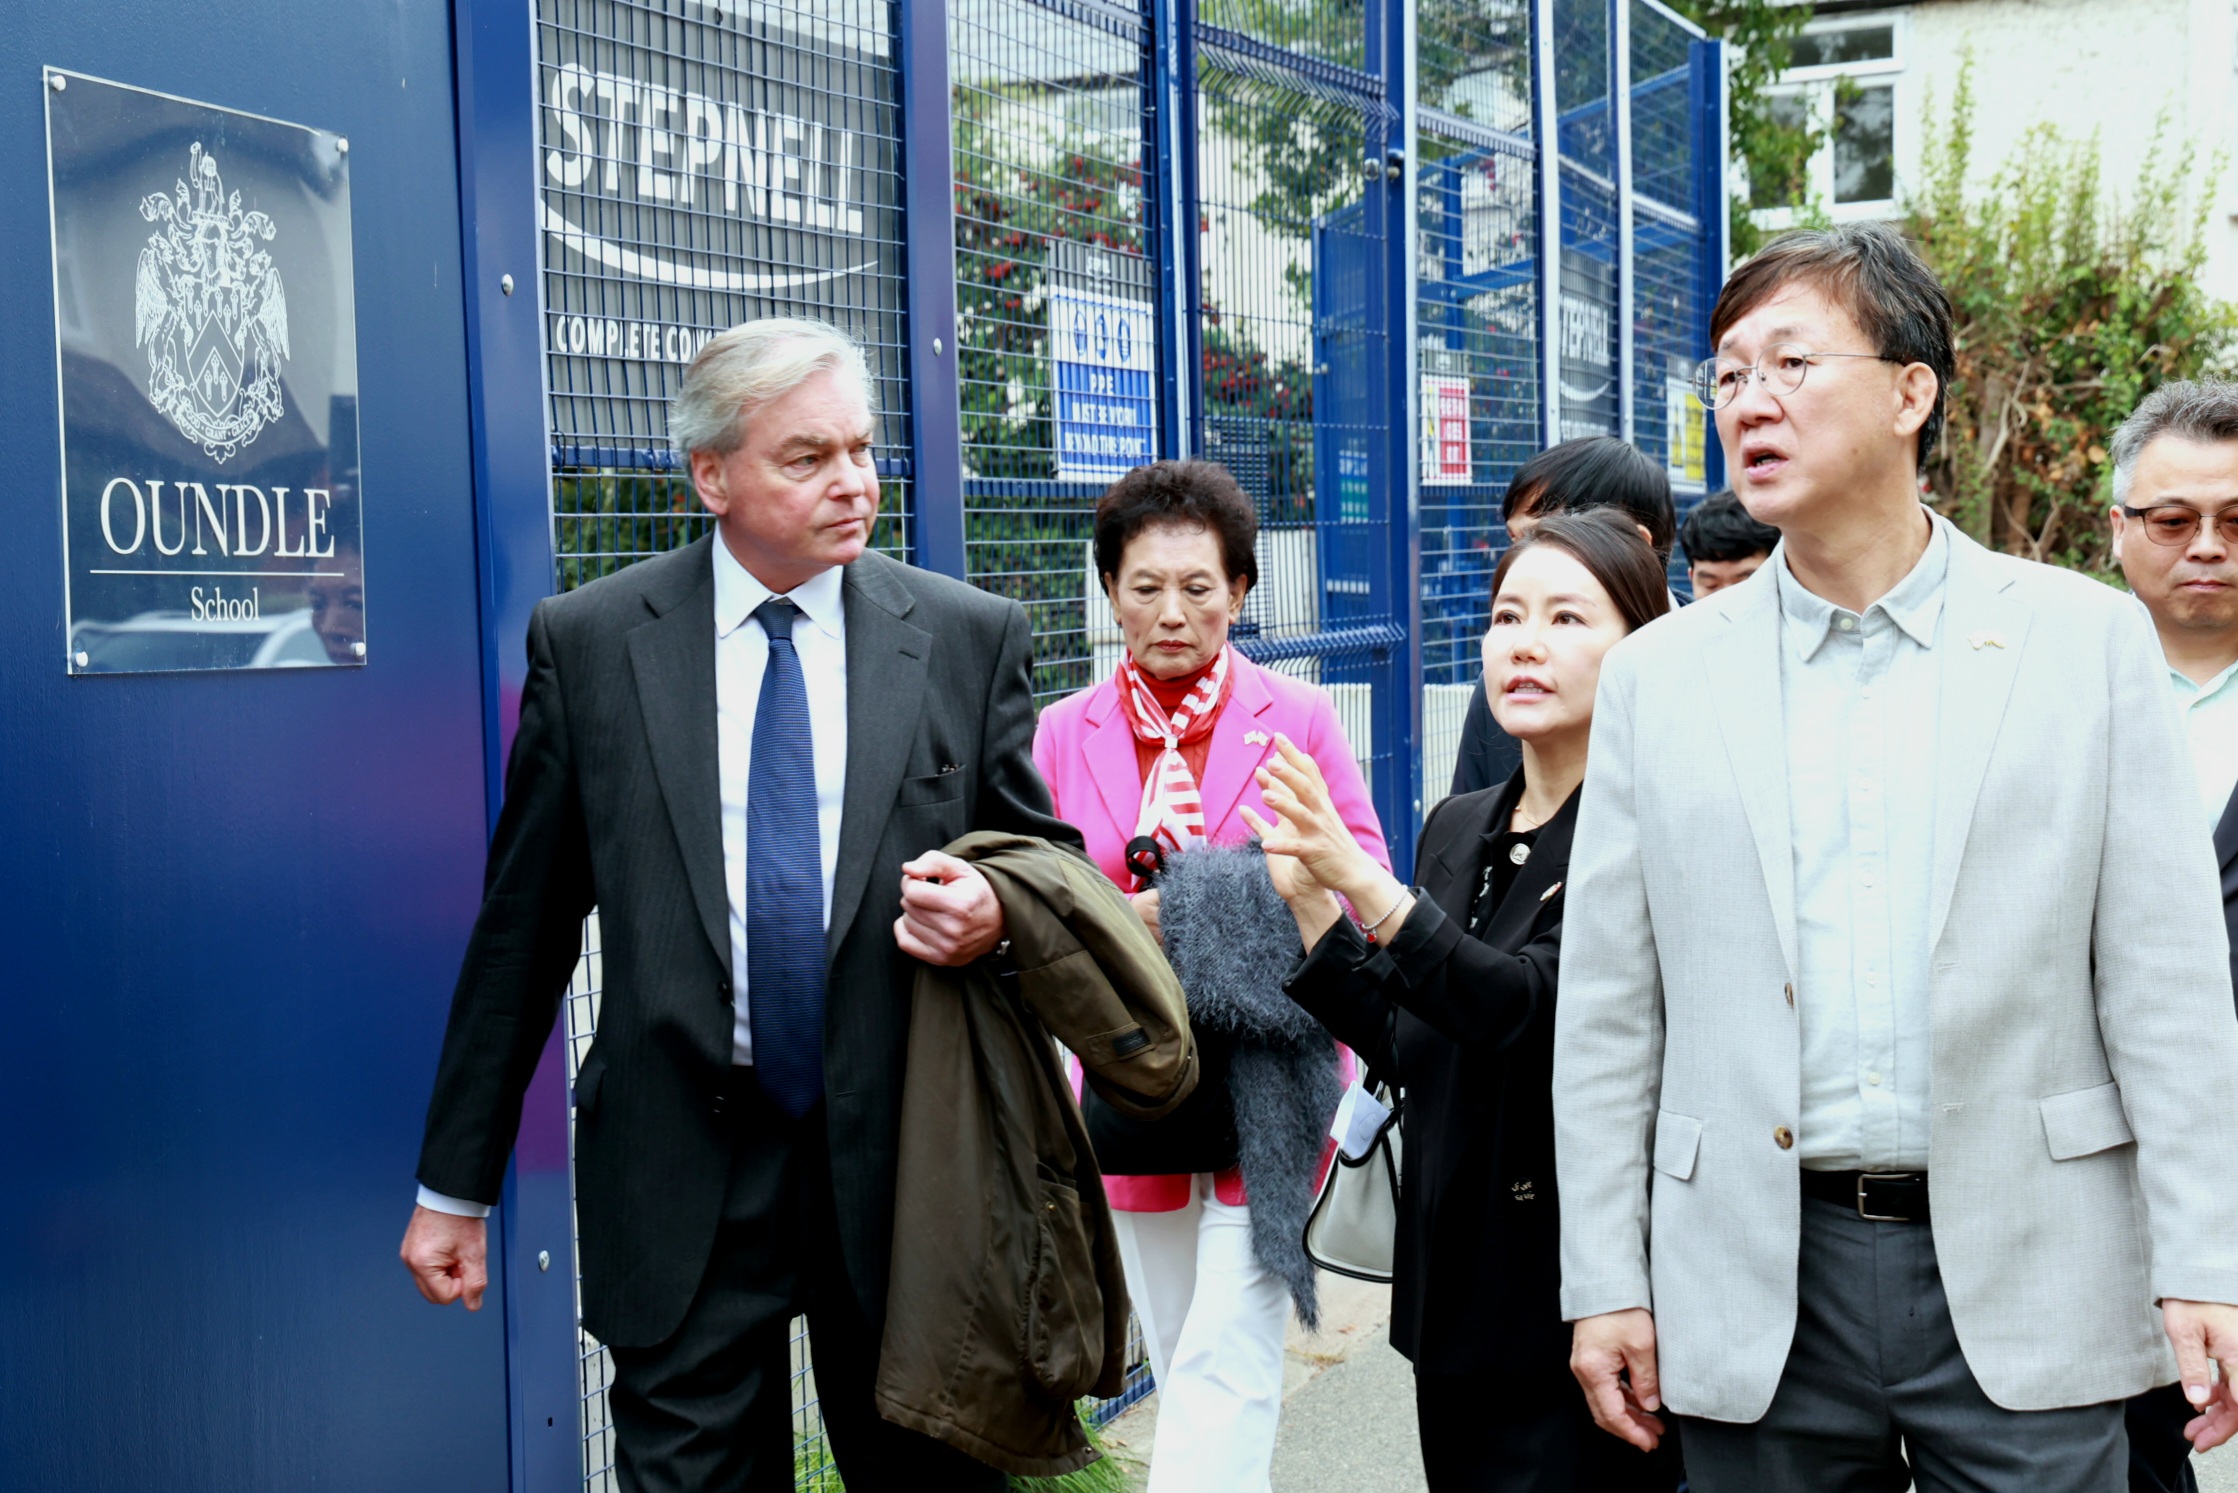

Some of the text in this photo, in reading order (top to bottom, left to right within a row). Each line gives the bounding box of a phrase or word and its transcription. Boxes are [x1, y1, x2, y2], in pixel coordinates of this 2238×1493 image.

[546, 62, 863, 234] STEPNELL
[556, 315, 661, 360] COMPLETE
[1089, 373, 1115, 396] PPE
[205, 427, 227, 440] GRANT
[100, 477, 335, 558] OUNDLE
[191, 586, 260, 623] School
